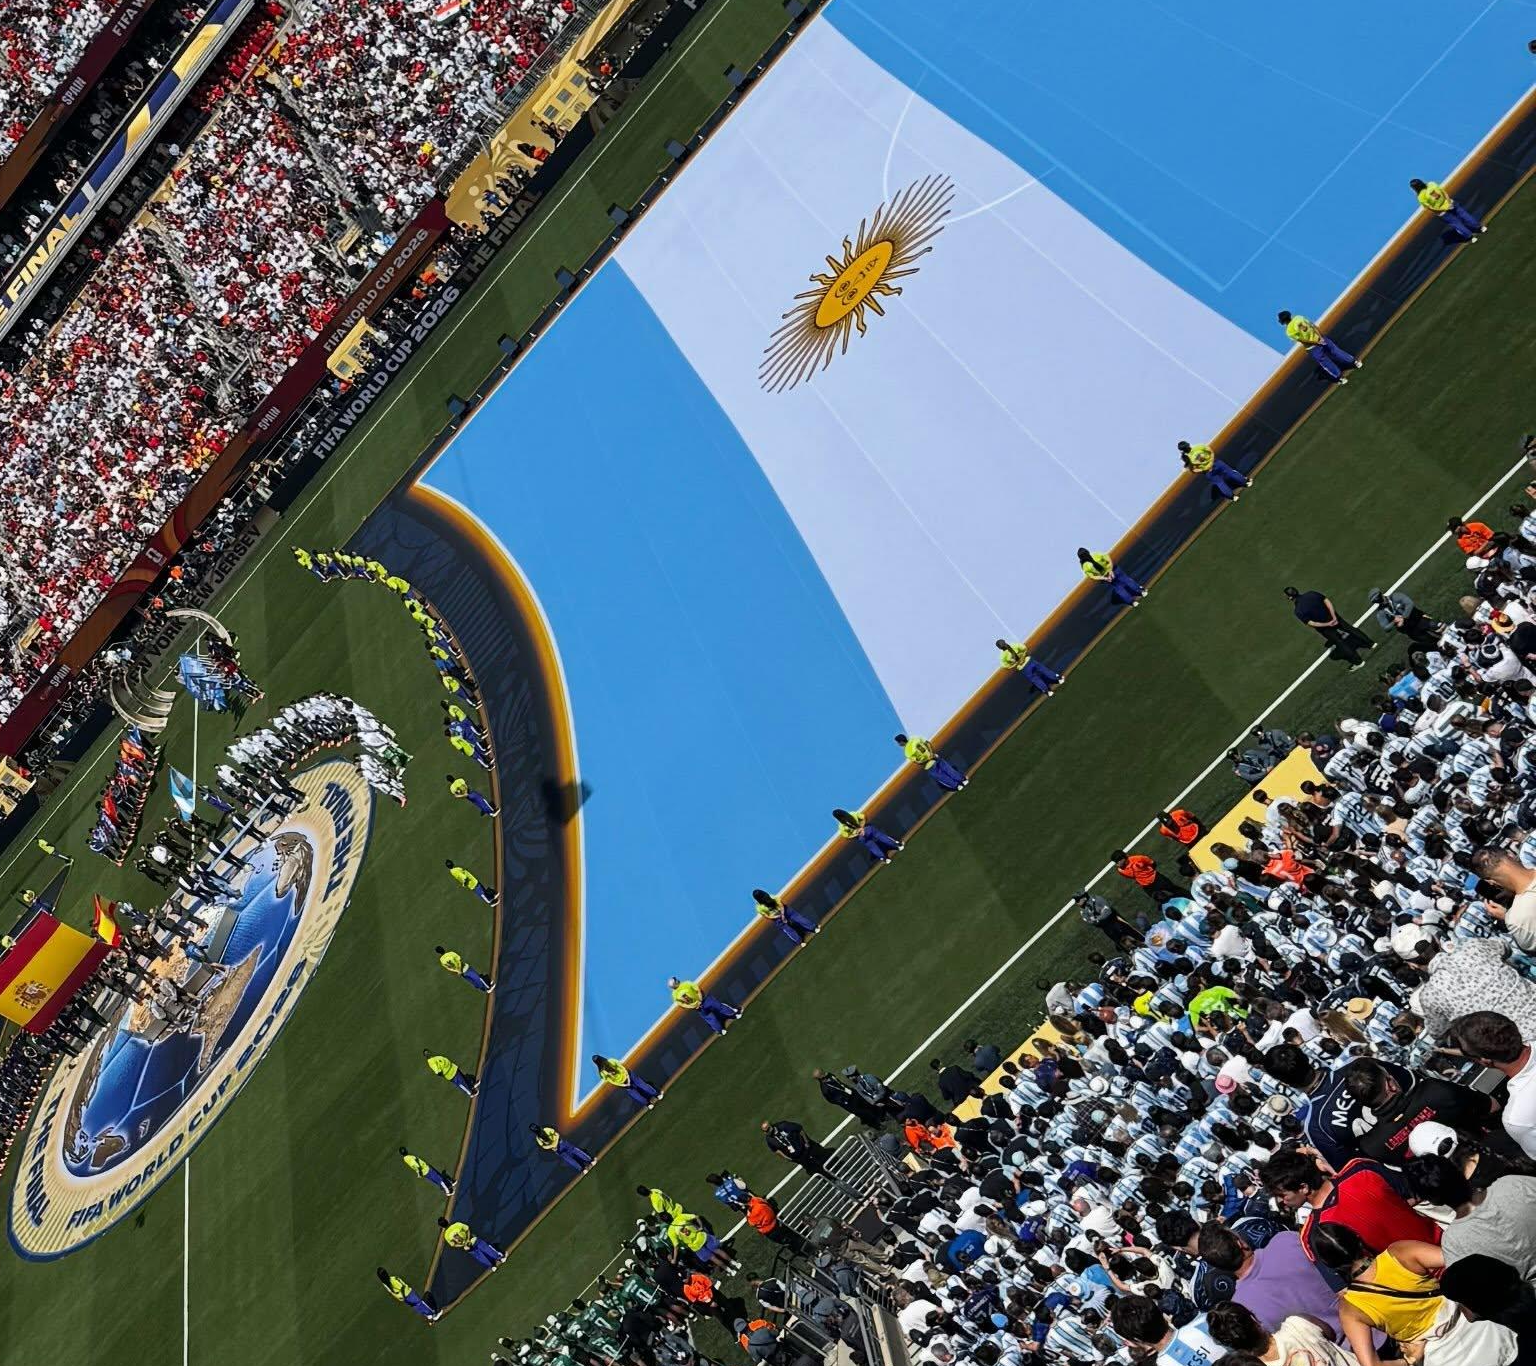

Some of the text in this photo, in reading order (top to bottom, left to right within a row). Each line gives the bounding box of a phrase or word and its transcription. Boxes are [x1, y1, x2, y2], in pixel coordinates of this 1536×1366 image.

[110, 5, 139, 38] FIFA
[61, 76, 87, 106] SPAIN
[2, 206, 81, 304] FINAL
[321, 225, 429, 354] FIFA WORLD CUP 2026
[312, 183, 544, 461] FIFA WORLD CUP 2026 THE FINAL
[256, 404, 281, 433] SPAIN
[148, 523, 263, 660] YORK JERSEY
[49, 662, 72, 689] SPAIN
[322, 780, 354, 903] THE FINAL
[67, 958, 310, 1228] FIFA WORLD CUP 2026
[25, 1088, 66, 1227] THE FINAL
